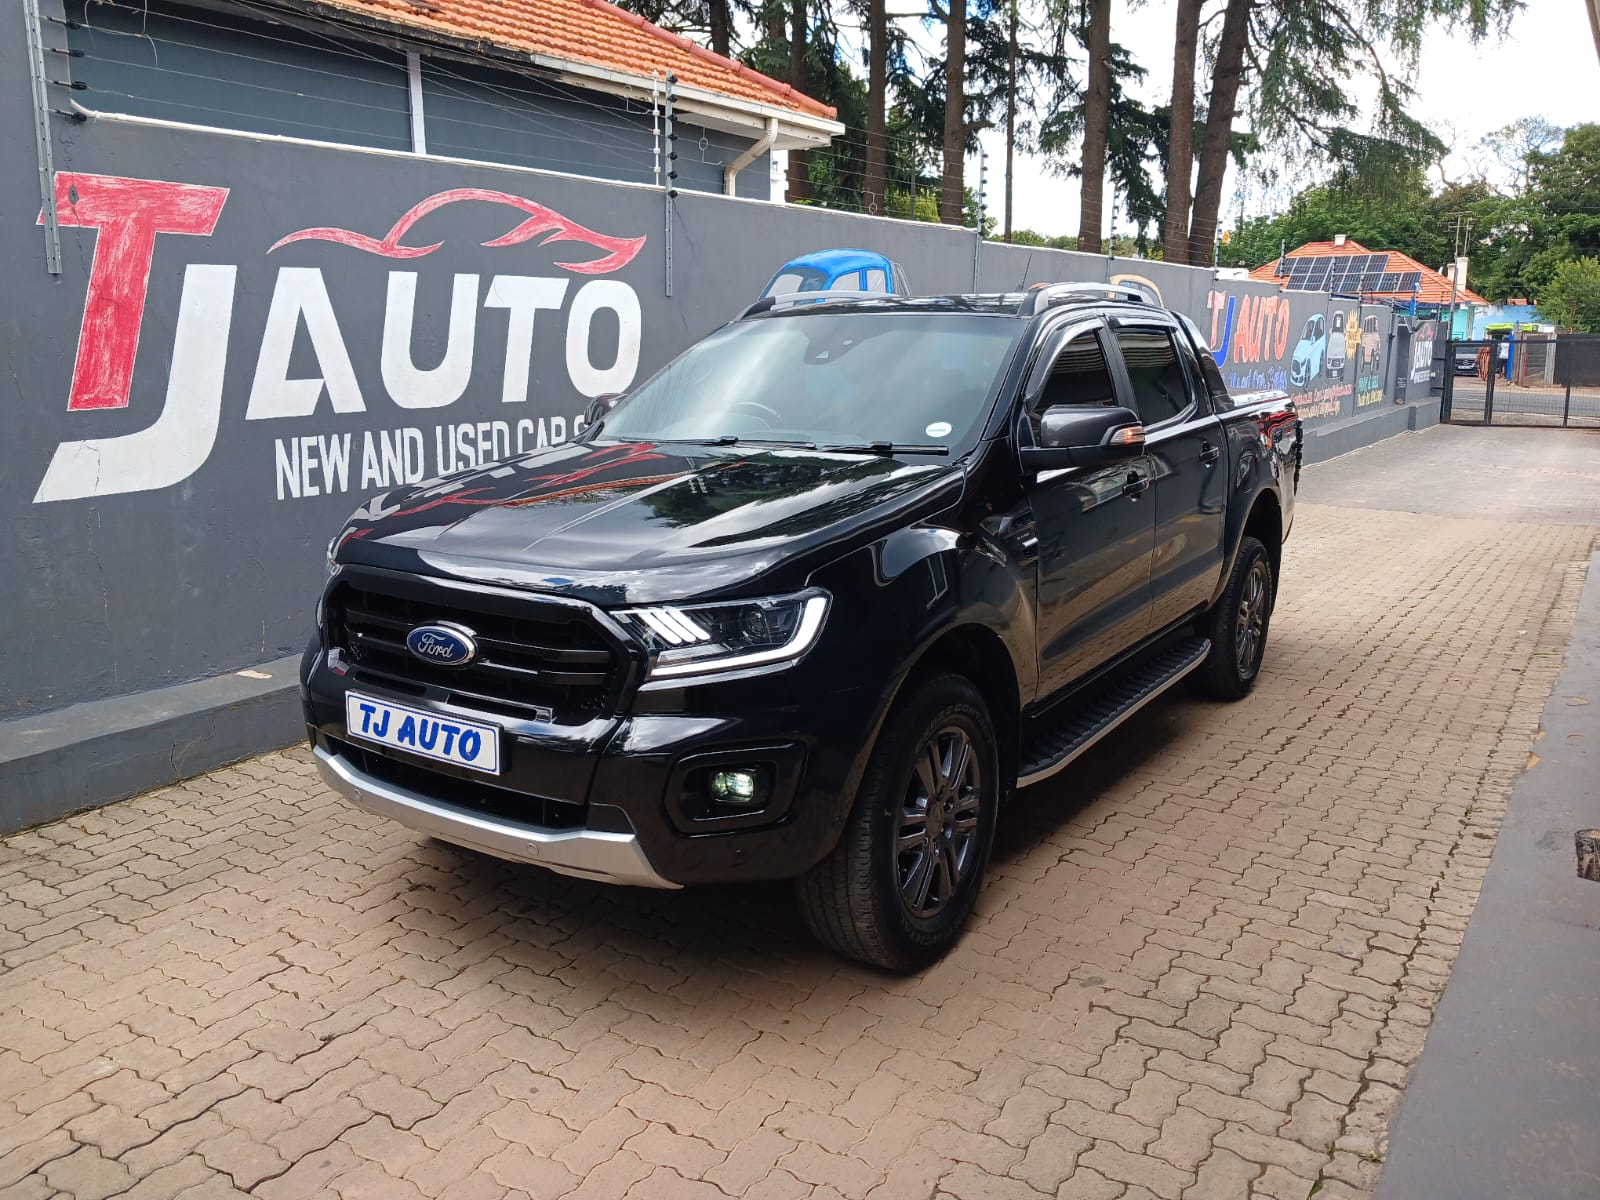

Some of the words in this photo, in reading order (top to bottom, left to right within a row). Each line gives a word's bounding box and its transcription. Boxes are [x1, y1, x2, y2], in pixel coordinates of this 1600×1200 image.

[33, 171, 237, 504] TJ
[246, 266, 641, 421] AUTO
[1207, 290, 1236, 368] TJ
[1233, 293, 1291, 363] AUTO
[275, 433, 351, 500] NEW
[361, 428, 425, 489] AND
[435, 420, 510, 472] USED
[417, 633, 454, 658] Ford
[359, 705, 391, 738] TJ
[398, 716, 481, 761] AUTO
